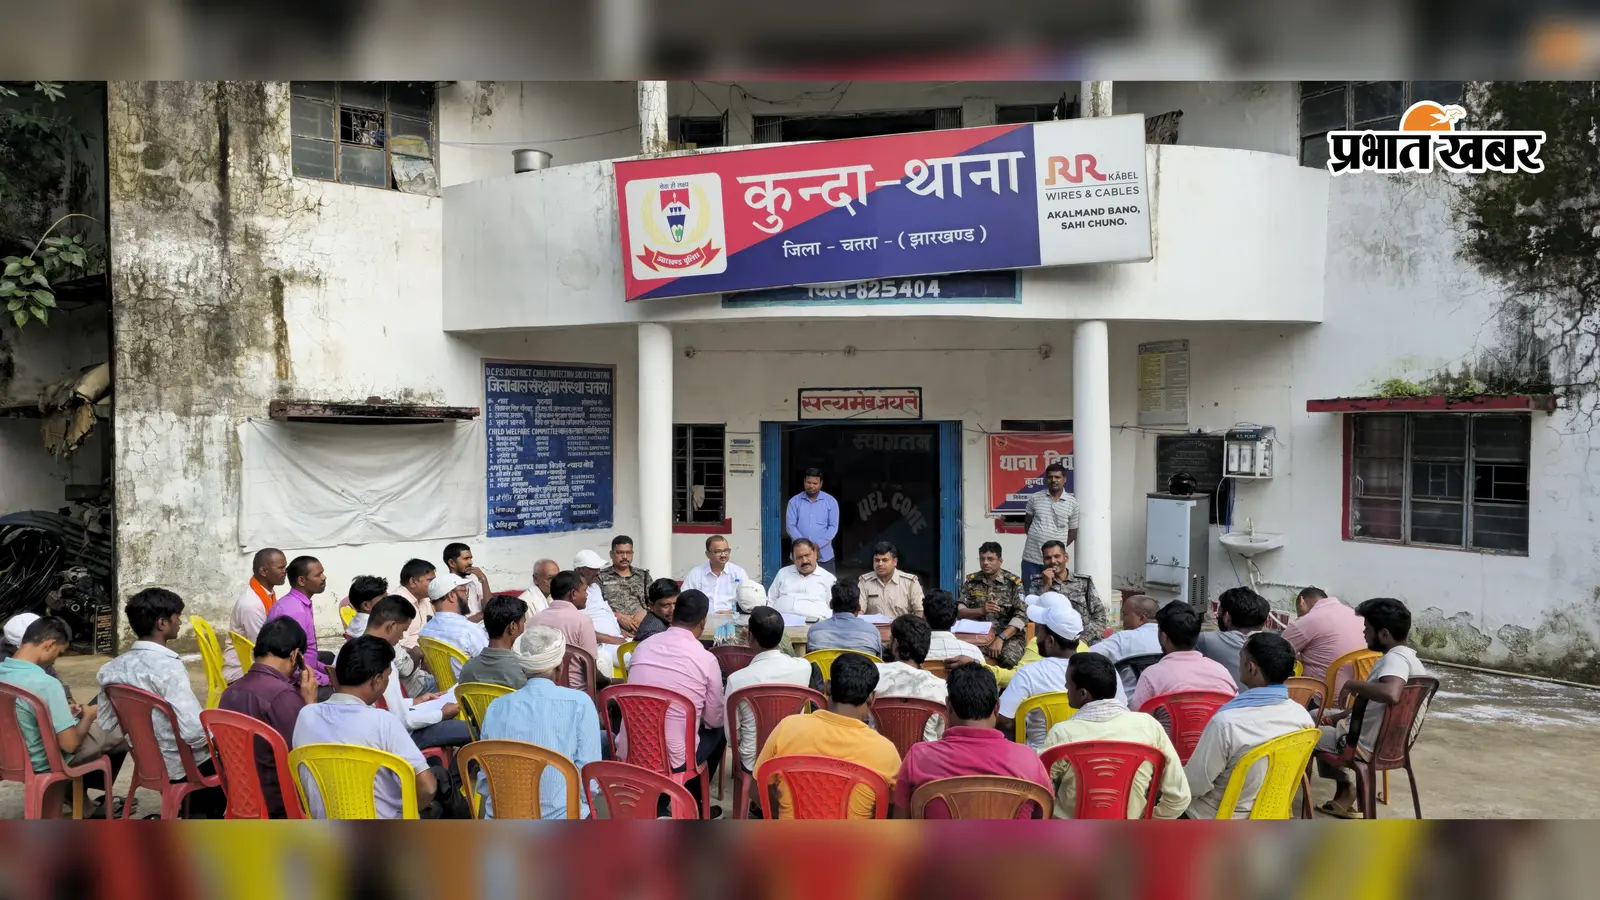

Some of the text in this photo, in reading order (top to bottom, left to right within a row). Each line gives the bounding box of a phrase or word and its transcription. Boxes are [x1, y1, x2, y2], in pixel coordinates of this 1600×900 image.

[1045, 186, 1140, 201] WIRES & CABLES
[1047, 205, 1141, 220] AKALMAND BANO,
[1061, 217, 1128, 230] SAHI CHUNO.
[782, 239, 821, 258] जिला
[839, 236, 879, 252] चतरा
[505, 367, 533, 377] DISTRICT
[487, 376, 511, 393] जिला
[510, 379, 529, 393] बाल
[528, 379, 560, 397] संरक्षण
[488, 427, 559, 436] CHILD WELFARE COMMITTEE
[999, 454, 1039, 472] थाना
[1023, 477, 1045, 489] कुन्दा
